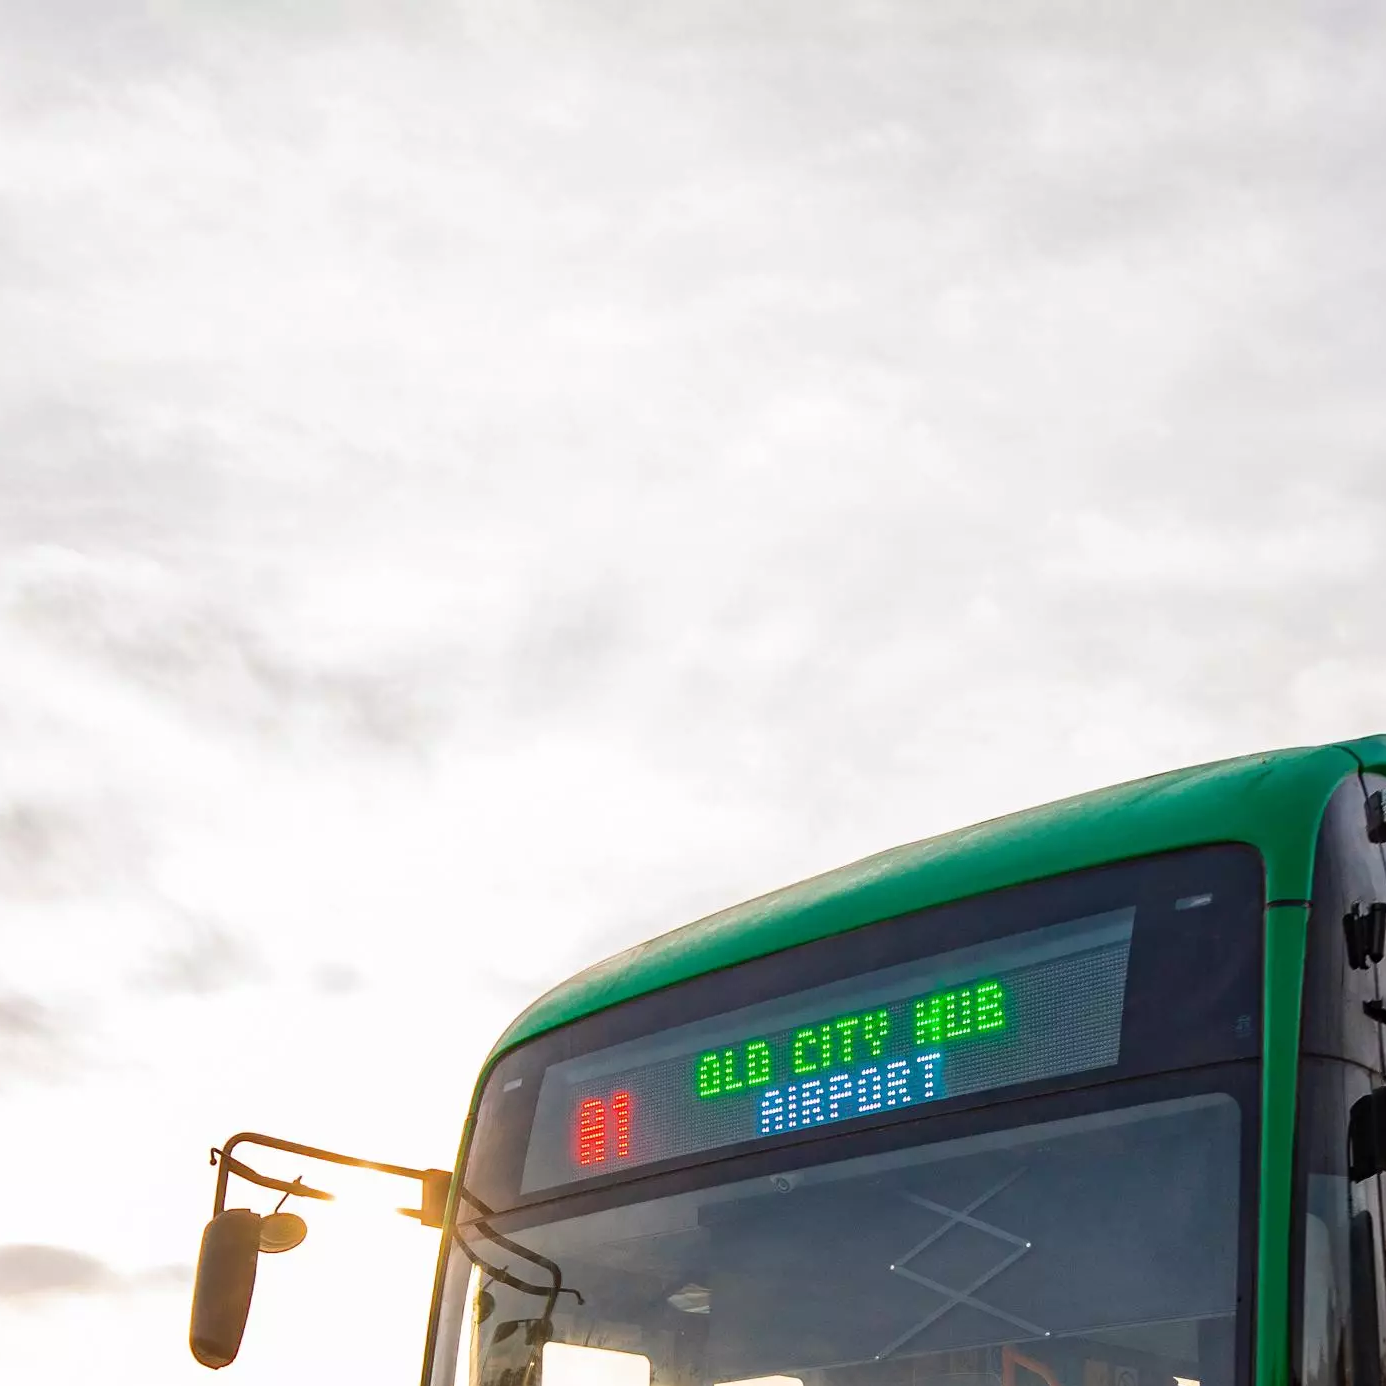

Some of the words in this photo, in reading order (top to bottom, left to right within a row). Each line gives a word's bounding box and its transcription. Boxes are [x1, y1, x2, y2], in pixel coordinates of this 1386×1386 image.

[699, 1040, 770, 1097] OLD
[794, 1010, 888, 1074] CITY
[916, 983, 1004, 1045] HUB
[580, 1093, 630, 1165] A1
[761, 1052, 942, 1134] AIRPORT
